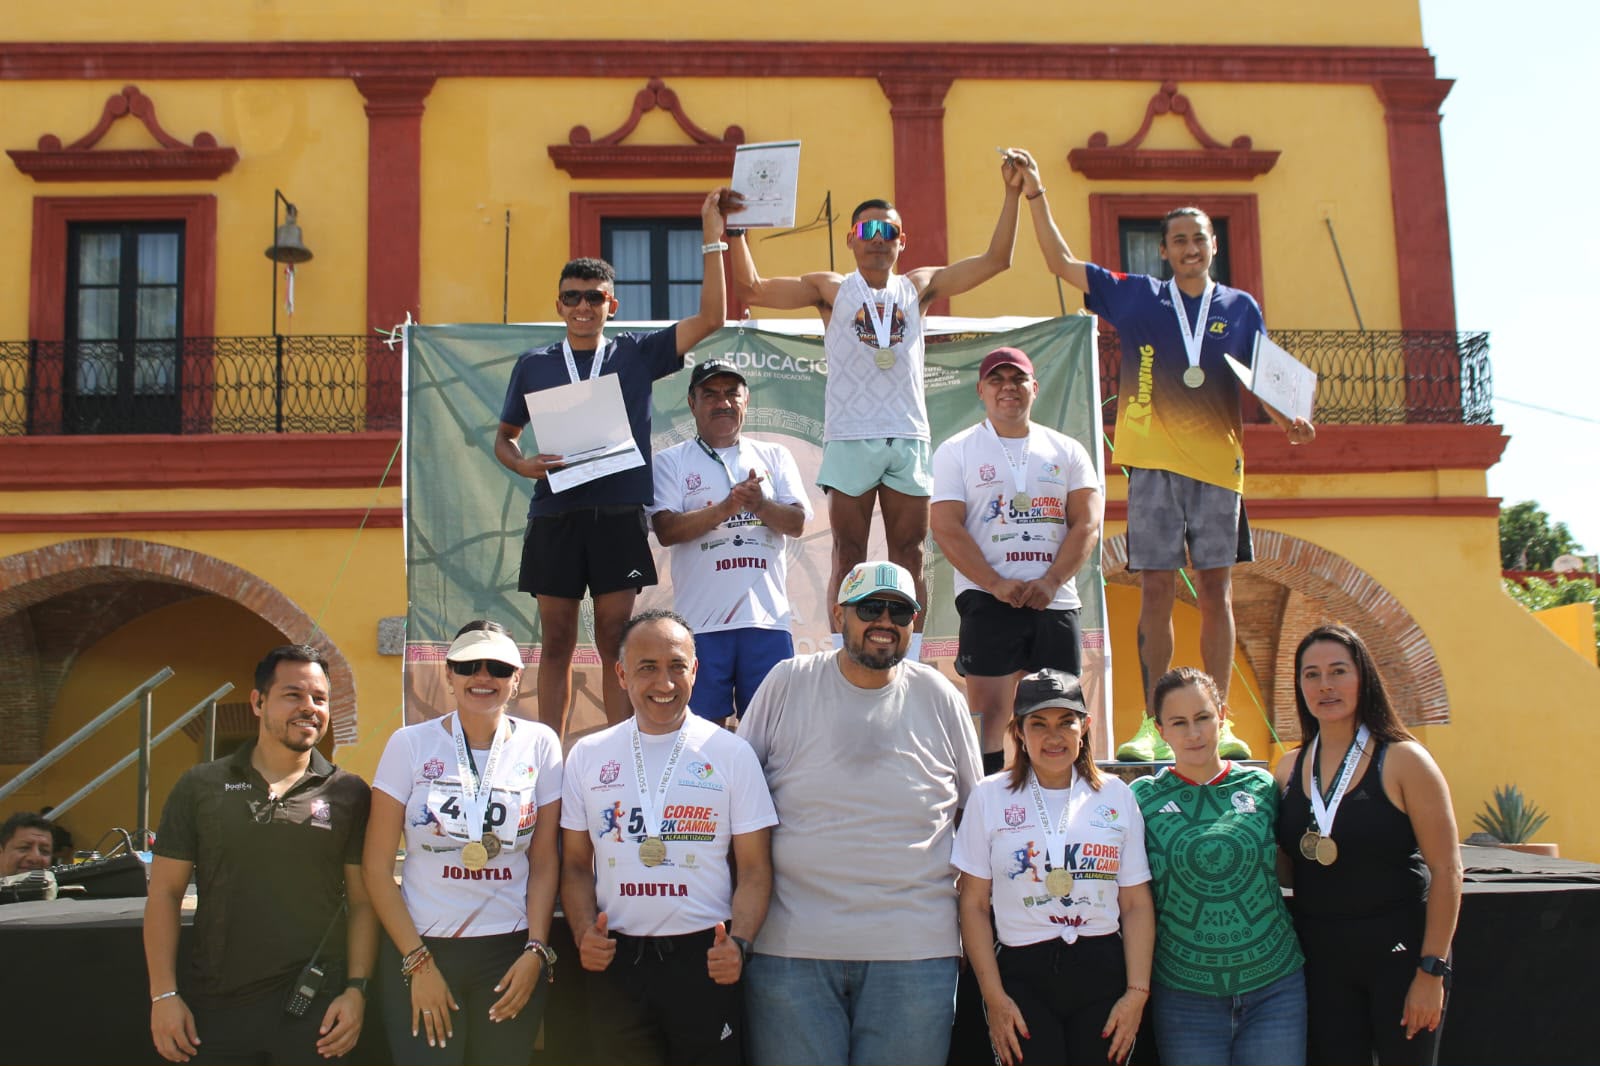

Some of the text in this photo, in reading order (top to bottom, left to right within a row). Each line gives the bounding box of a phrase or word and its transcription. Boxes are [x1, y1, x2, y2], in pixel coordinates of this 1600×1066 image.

[724, 352, 829, 375] EDUCACIÓ
[1031, 508, 1042, 517] 2K
[715, 557, 767, 571] JOJUTLA
[1005, 551, 1053, 563] JOJUTLA
[659, 731, 688, 788] INEEA MORELOS
[635, 752, 647, 788] MORELOS
[440, 796, 507, 826] 40
[628, 807, 647, 834] 5
[660, 819, 717, 833] 2K CAMINA
[1079, 856, 1097, 870] 2K
[442, 865, 512, 880] JOJUTLA
[619, 882, 689, 897] JOJUTLA
